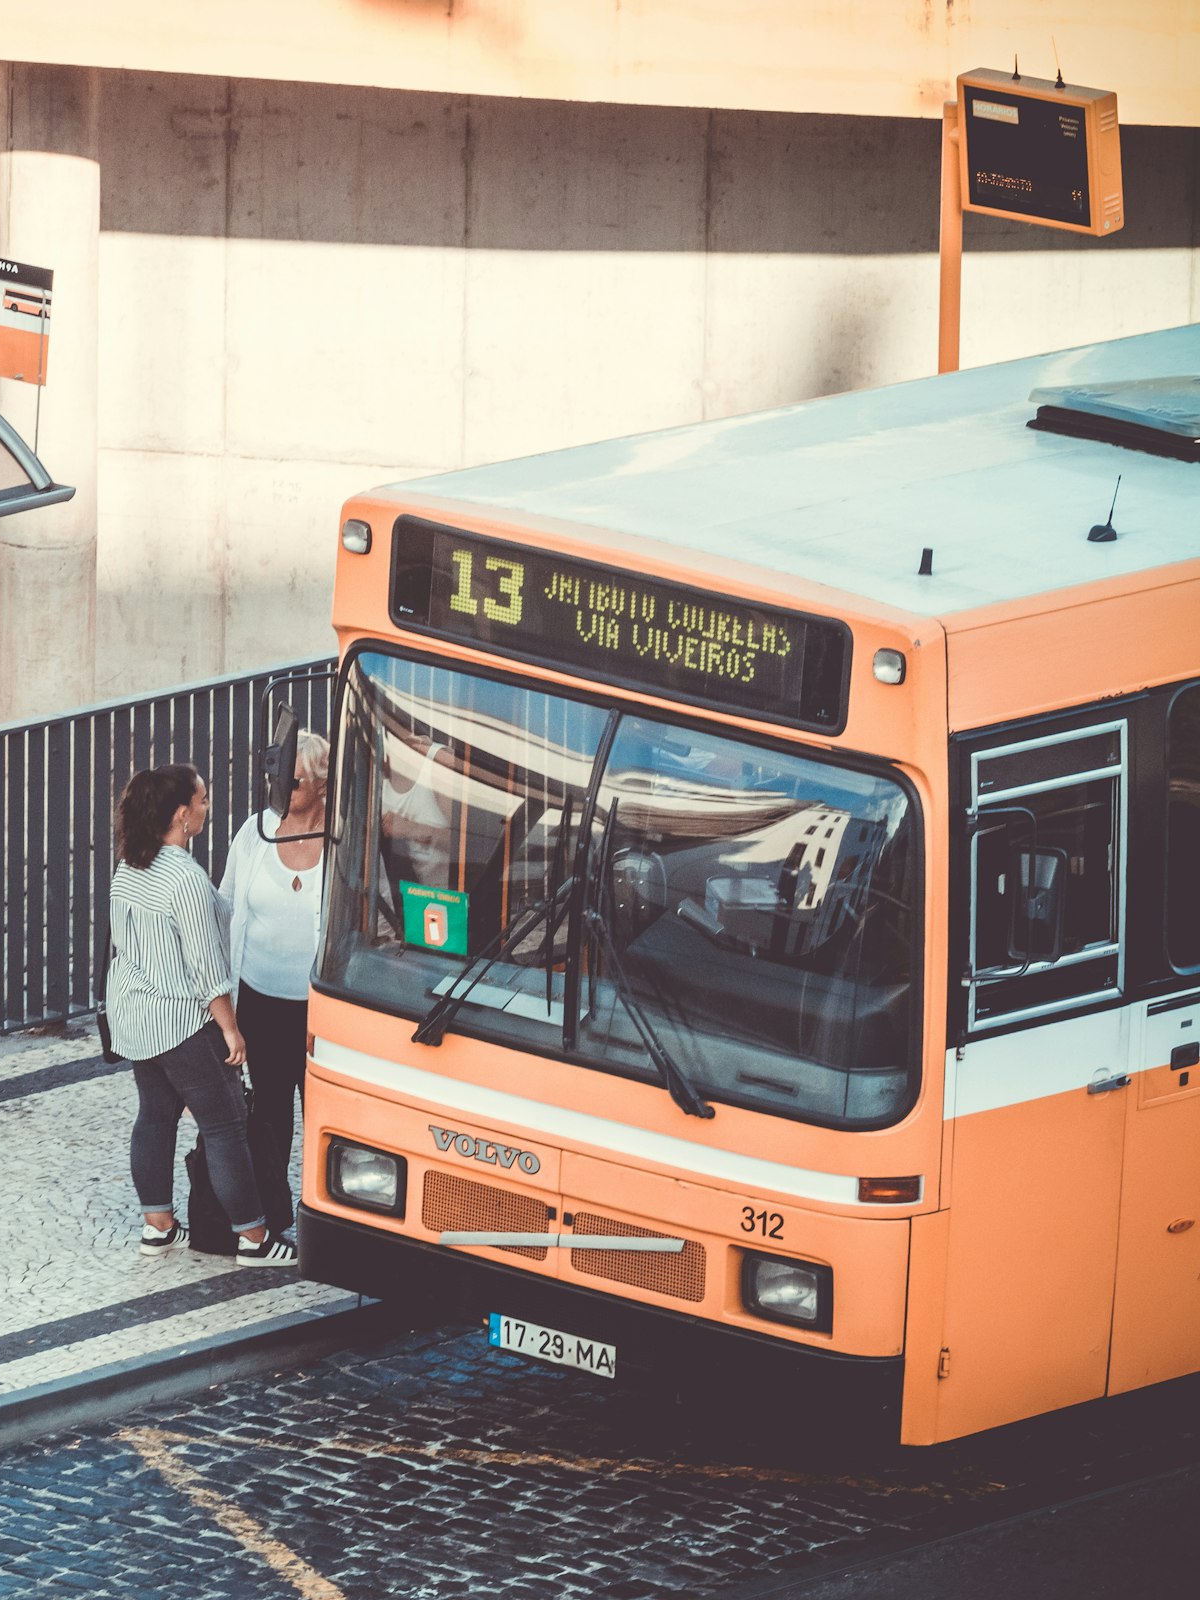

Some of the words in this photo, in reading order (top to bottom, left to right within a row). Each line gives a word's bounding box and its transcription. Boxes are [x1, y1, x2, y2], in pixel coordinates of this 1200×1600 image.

[450, 549, 525, 626] 13
[576, 610, 619, 650] VIA
[633, 624, 756, 682] VIVEIROS
[428, 1124, 541, 1175] VOLVO
[741, 1206, 784, 1240] 312
